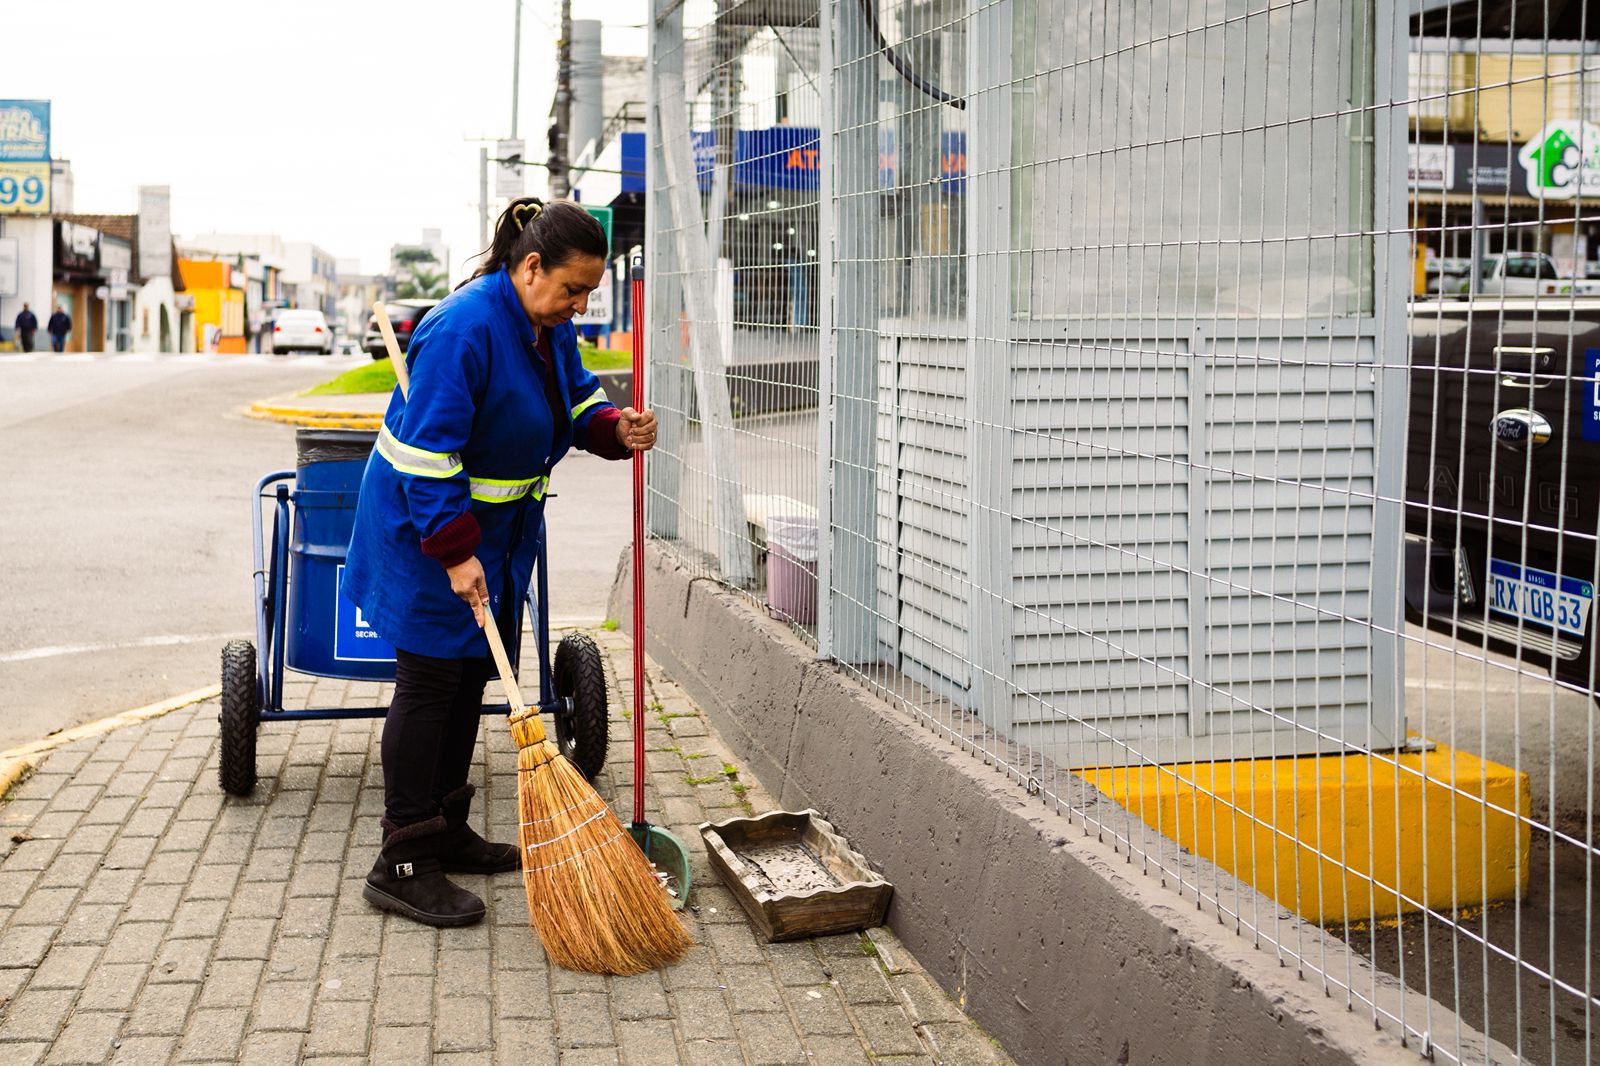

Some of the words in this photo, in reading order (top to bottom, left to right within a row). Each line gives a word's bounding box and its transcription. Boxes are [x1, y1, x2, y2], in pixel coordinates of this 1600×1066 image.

[786, 149, 821, 170] AT
[1497, 419, 1521, 438] Ford
[1528, 574, 1546, 586] BRASIL
[355, 630, 381, 638] SECRE
